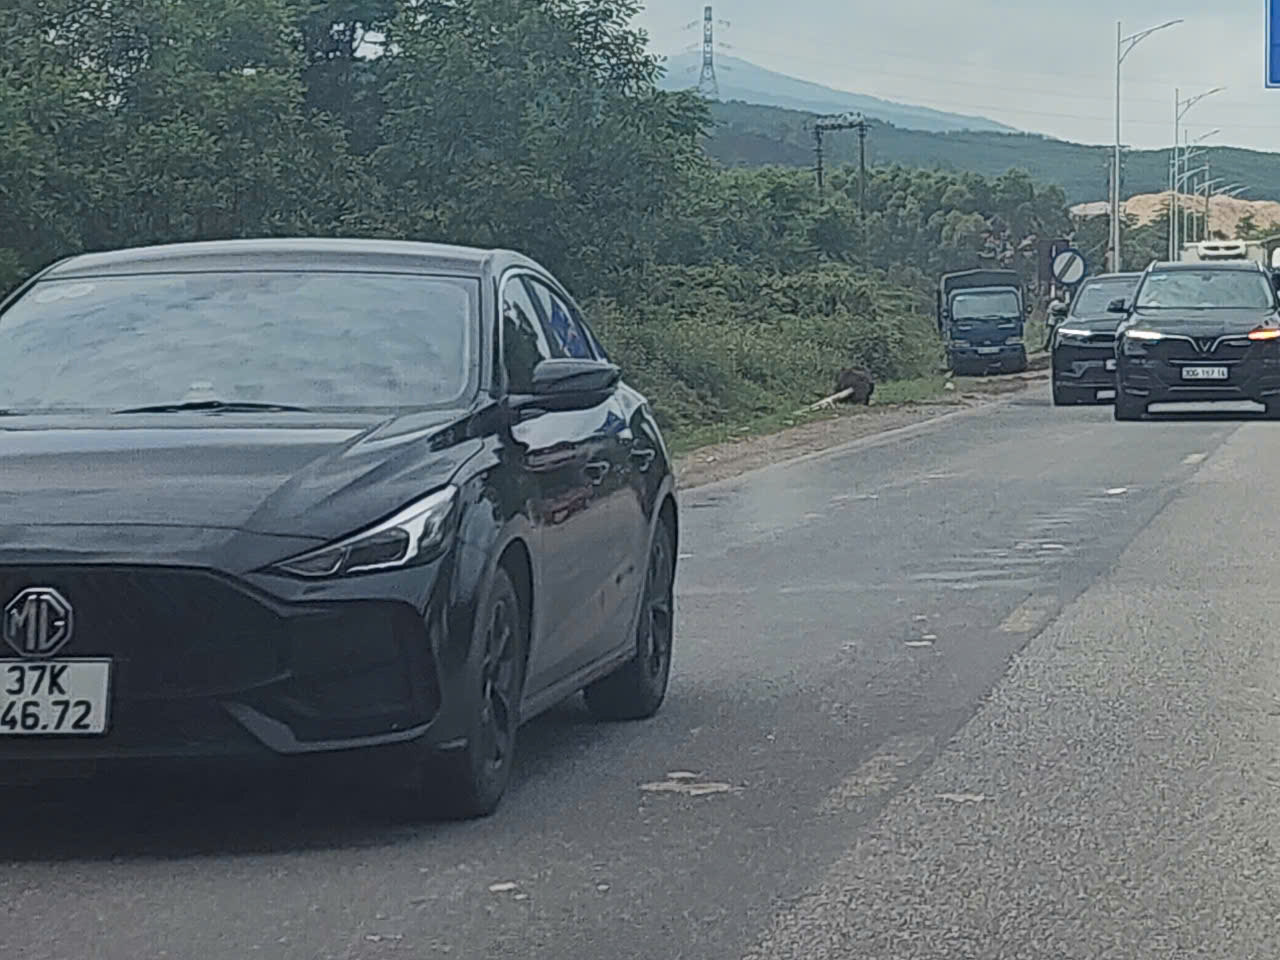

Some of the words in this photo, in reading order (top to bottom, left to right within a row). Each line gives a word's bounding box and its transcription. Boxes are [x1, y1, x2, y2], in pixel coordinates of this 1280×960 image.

[9, 594, 66, 651] MG
[6, 665, 69, 696] 37K
[0, 699, 92, 731] 46.72
